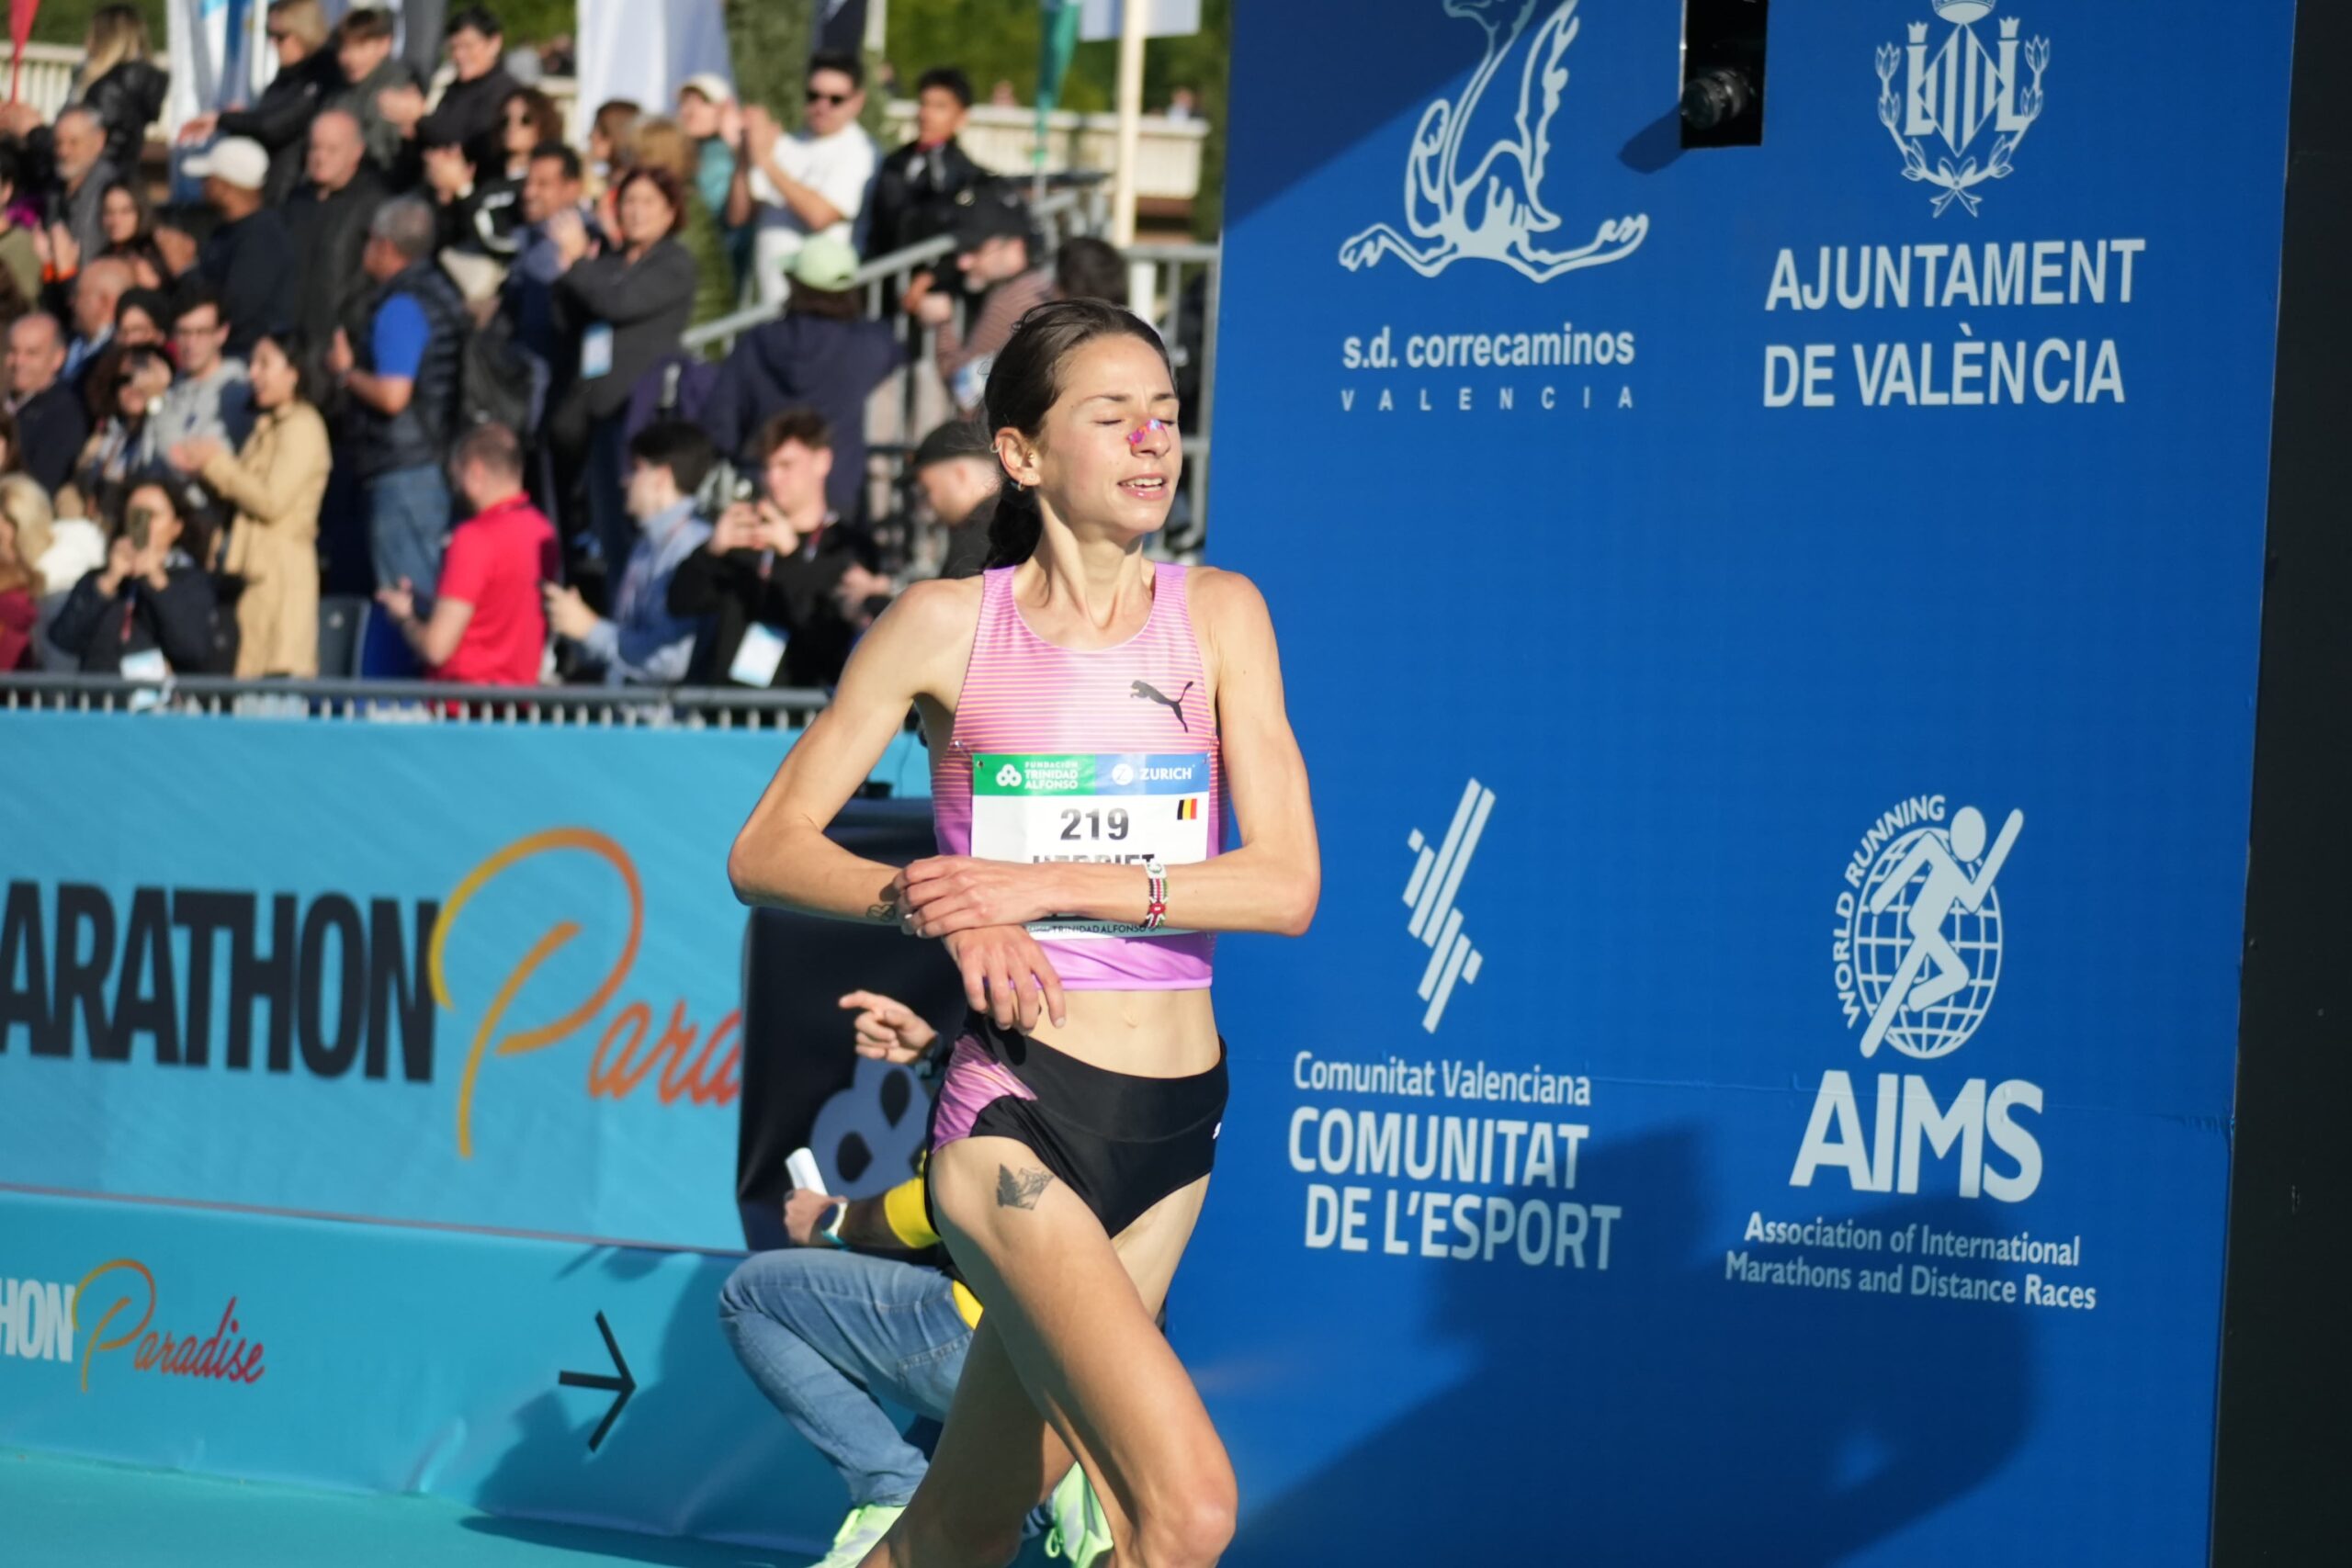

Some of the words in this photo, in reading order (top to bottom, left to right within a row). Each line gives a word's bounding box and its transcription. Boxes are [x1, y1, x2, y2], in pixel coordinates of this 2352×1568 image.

[1766, 240, 2147, 313] AJUNTAMENT
[1343, 335, 1399, 370] s.d.
[1407, 322, 1635, 369] correcaminos
[1764, 344, 1838, 410] DE
[1853, 323, 2126, 408] VALÈNCIA
[1342, 386, 1634, 412] VALENCIA
[1023, 779, 1079, 790] ALFONSO
[1024, 769, 1079, 780] TRINIDAD
[1139, 766, 1193, 781] ZURICH
[1060, 807, 1129, 840] 219
[1844, 795, 1946, 888] RUNNING
[1832, 891, 1861, 1030] WORLD
[1294, 1050, 1436, 1099] Comunitat
[1442, 1060, 1592, 1107] Valenciana
[1288, 1105, 1590, 1190] COMUNITAT
[1789, 1069, 2045, 1204] AIMS
[1304, 1183, 1373, 1253] DE
[1744, 1210, 1882, 1251] Association
[1888, 1224, 1917, 1254] of
[1921, 1226, 2081, 1268] International
[1724, 1250, 1852, 1292] Marathons
[1858, 1265, 1904, 1295] and
[1910, 1266, 2018, 1304] Distance
[2023, 1273, 2098, 1311] Races
[71, 1258, 265, 1394] Paradise
